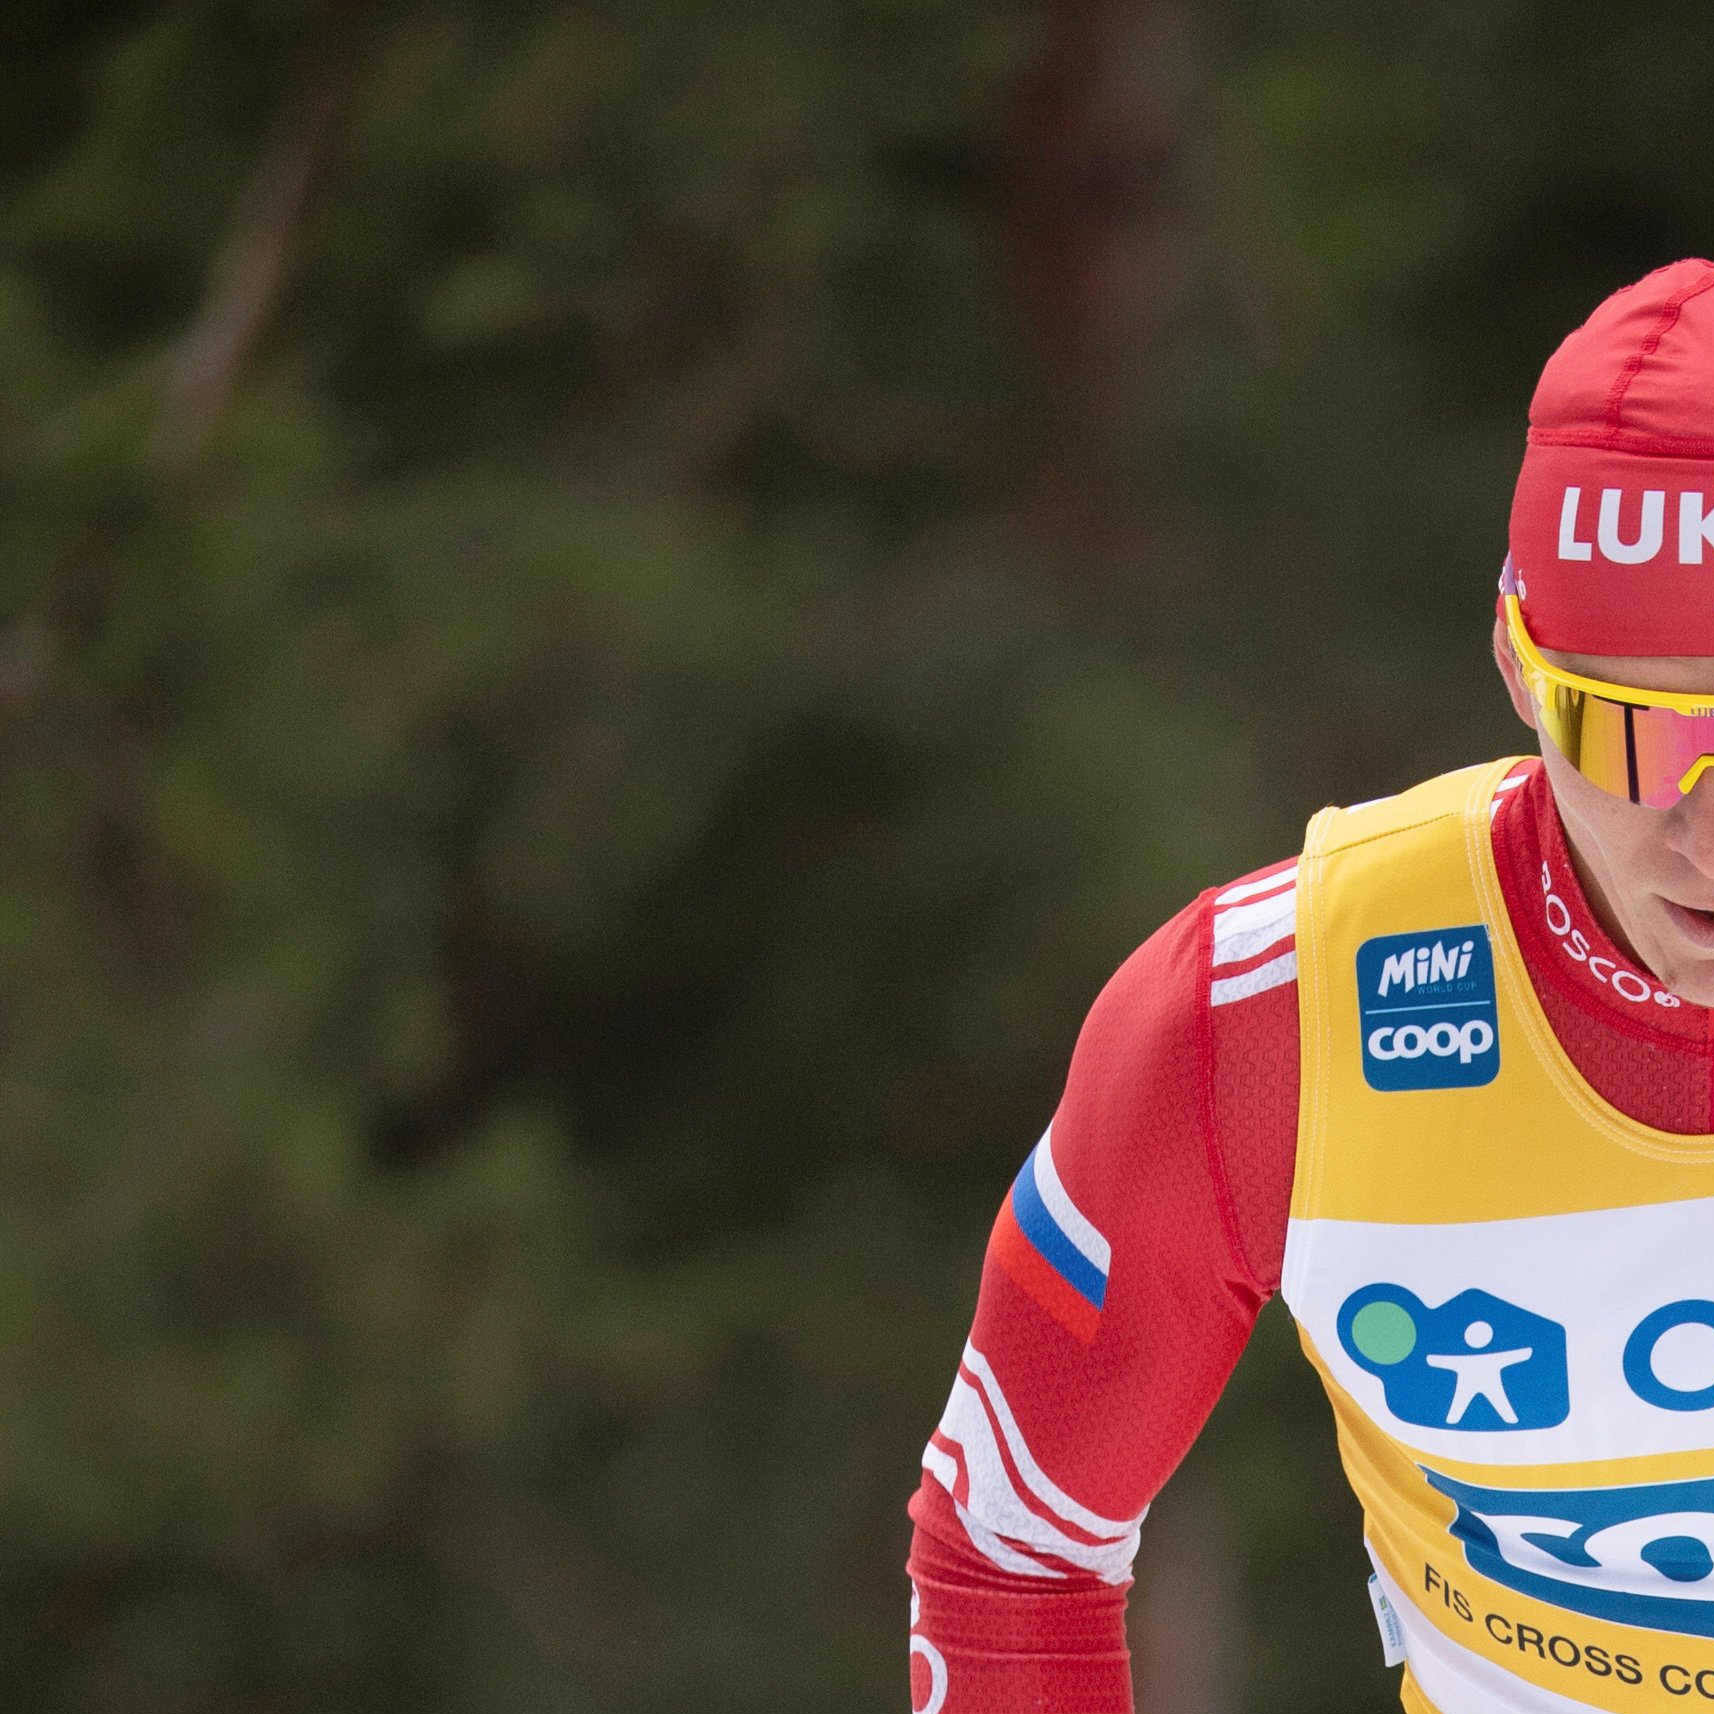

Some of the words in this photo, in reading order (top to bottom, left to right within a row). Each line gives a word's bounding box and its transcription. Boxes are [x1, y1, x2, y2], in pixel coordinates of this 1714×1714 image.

[1418, 984, 1454, 995] WORLD
[1457, 981, 1478, 992] CUP
[1368, 1019, 1494, 1064] coop
[1424, 1562, 1474, 1623] FIS
[1485, 1613, 1643, 1685] CROSS
